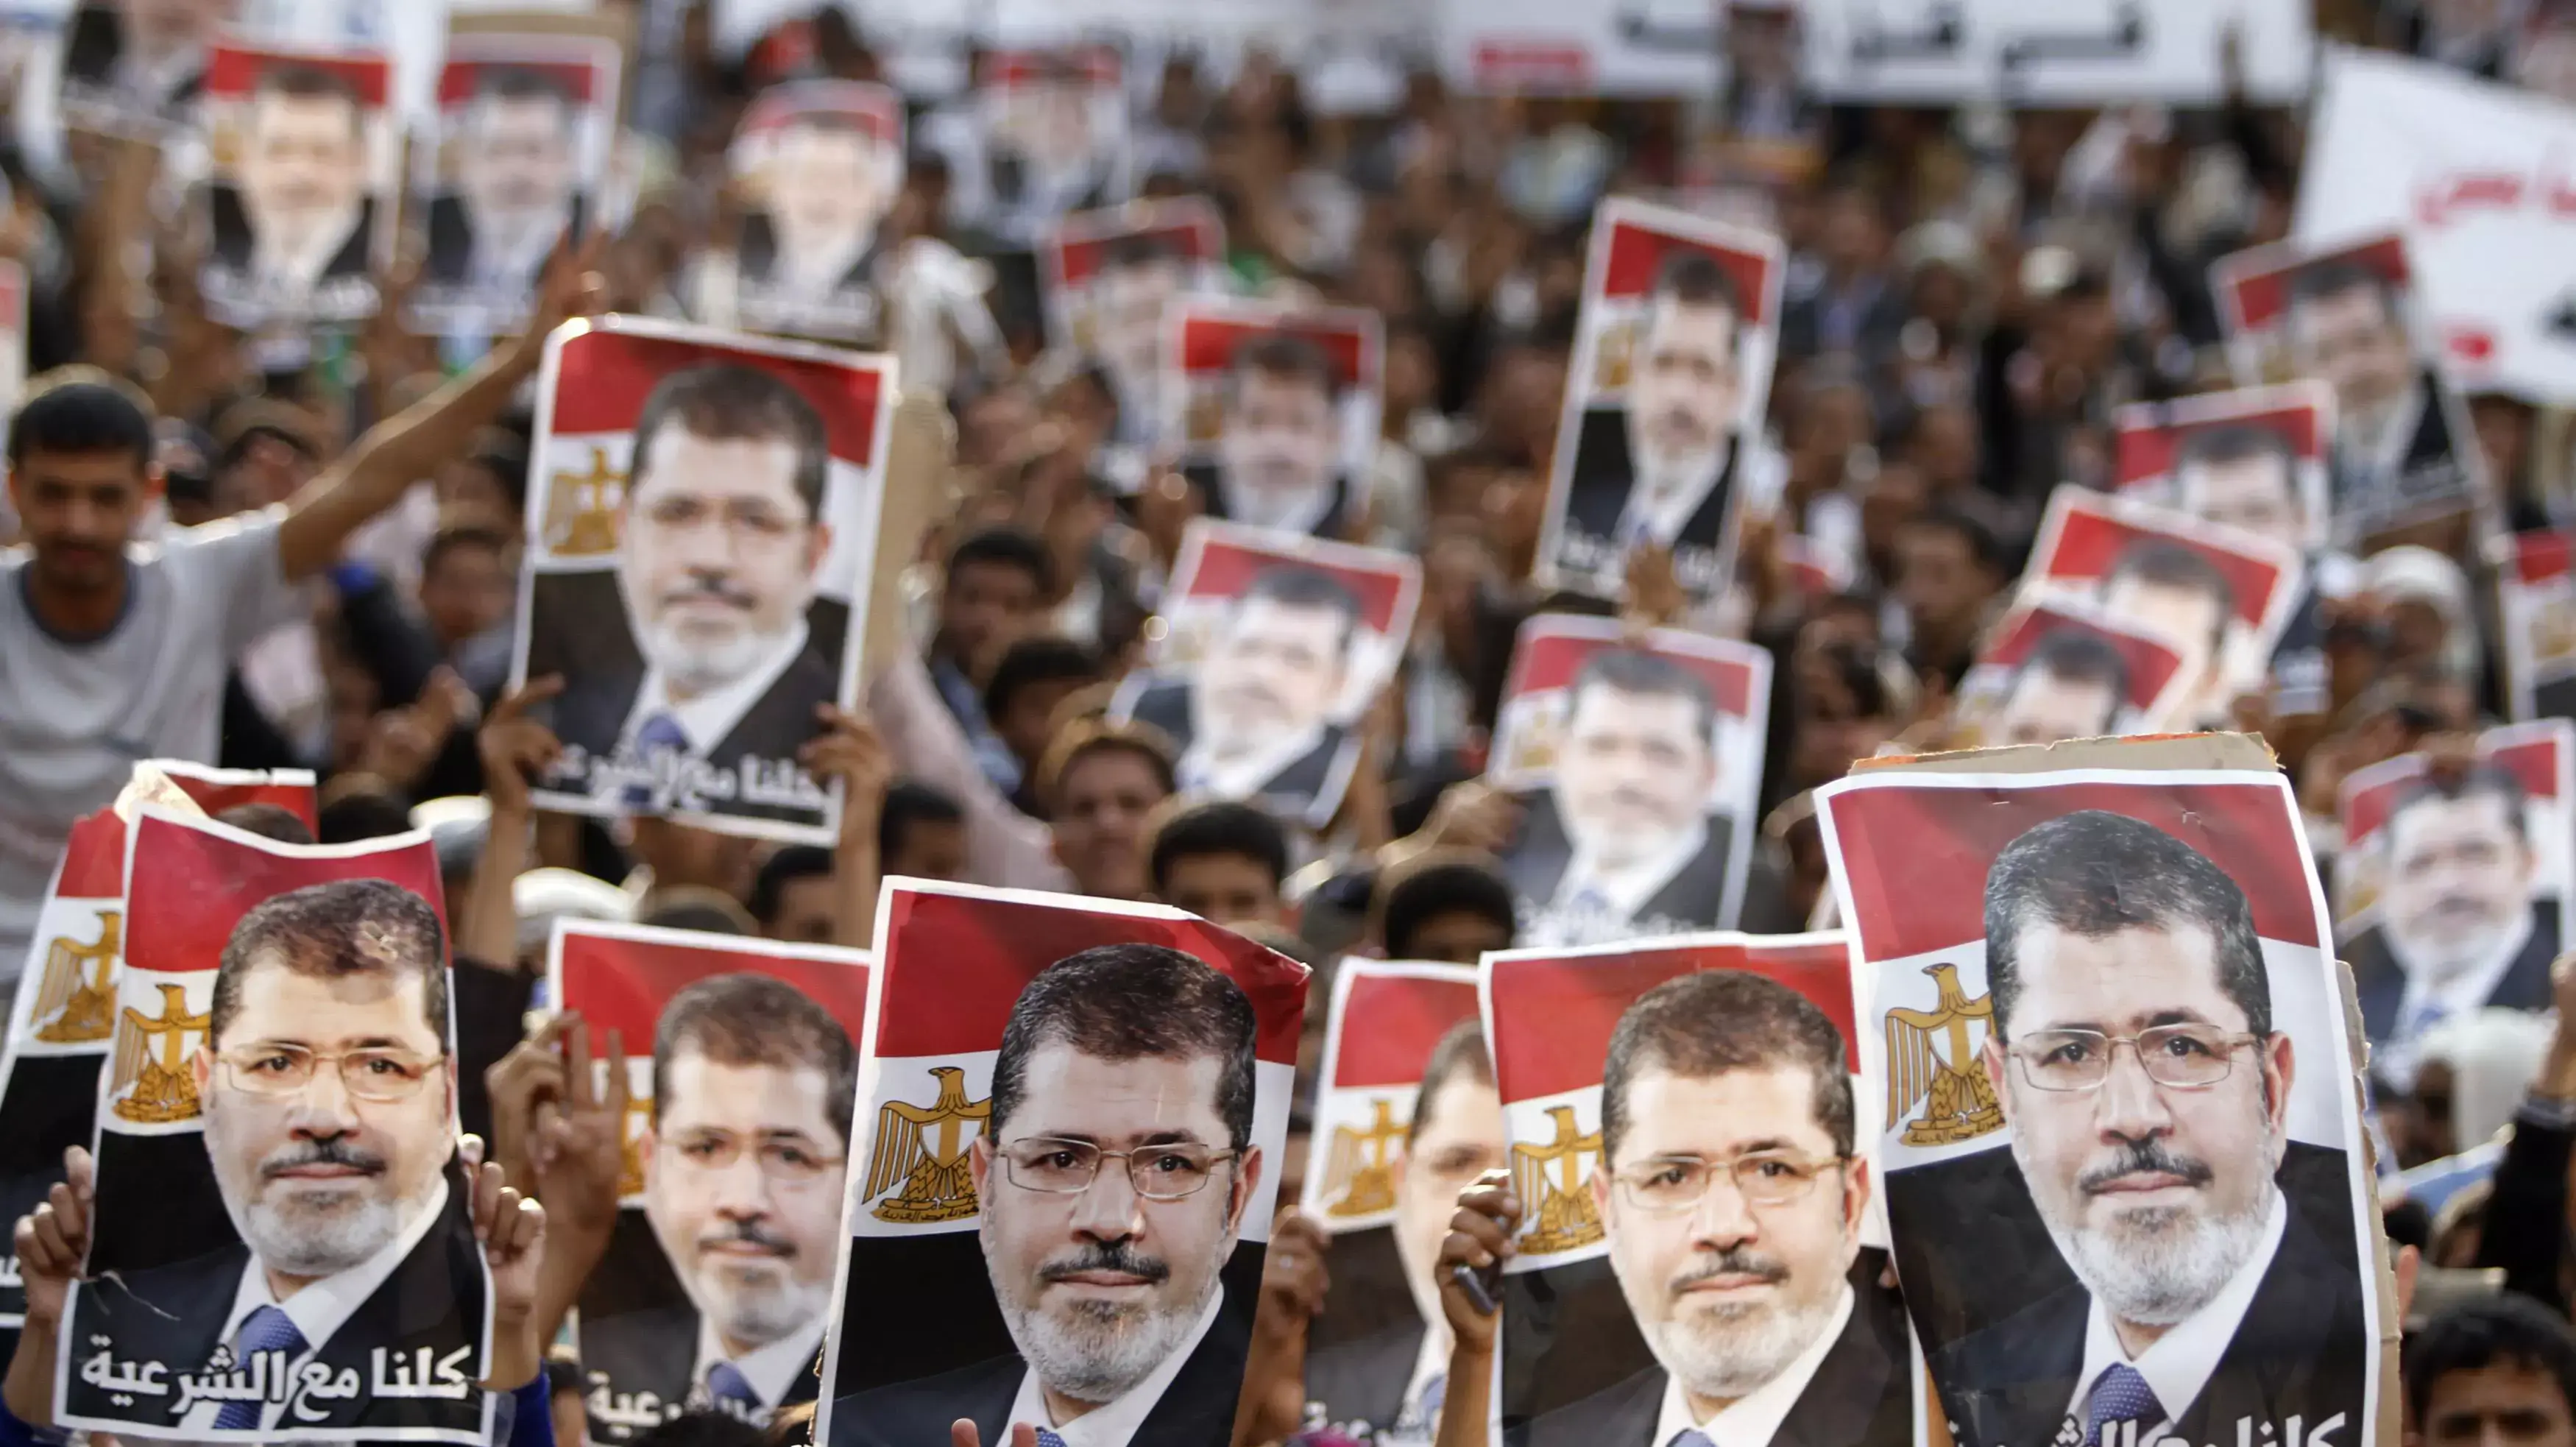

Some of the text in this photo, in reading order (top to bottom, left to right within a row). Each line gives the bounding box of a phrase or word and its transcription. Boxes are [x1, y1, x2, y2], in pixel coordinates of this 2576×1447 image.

[80, 1334, 473, 1421] كلنا مع الشرعية
